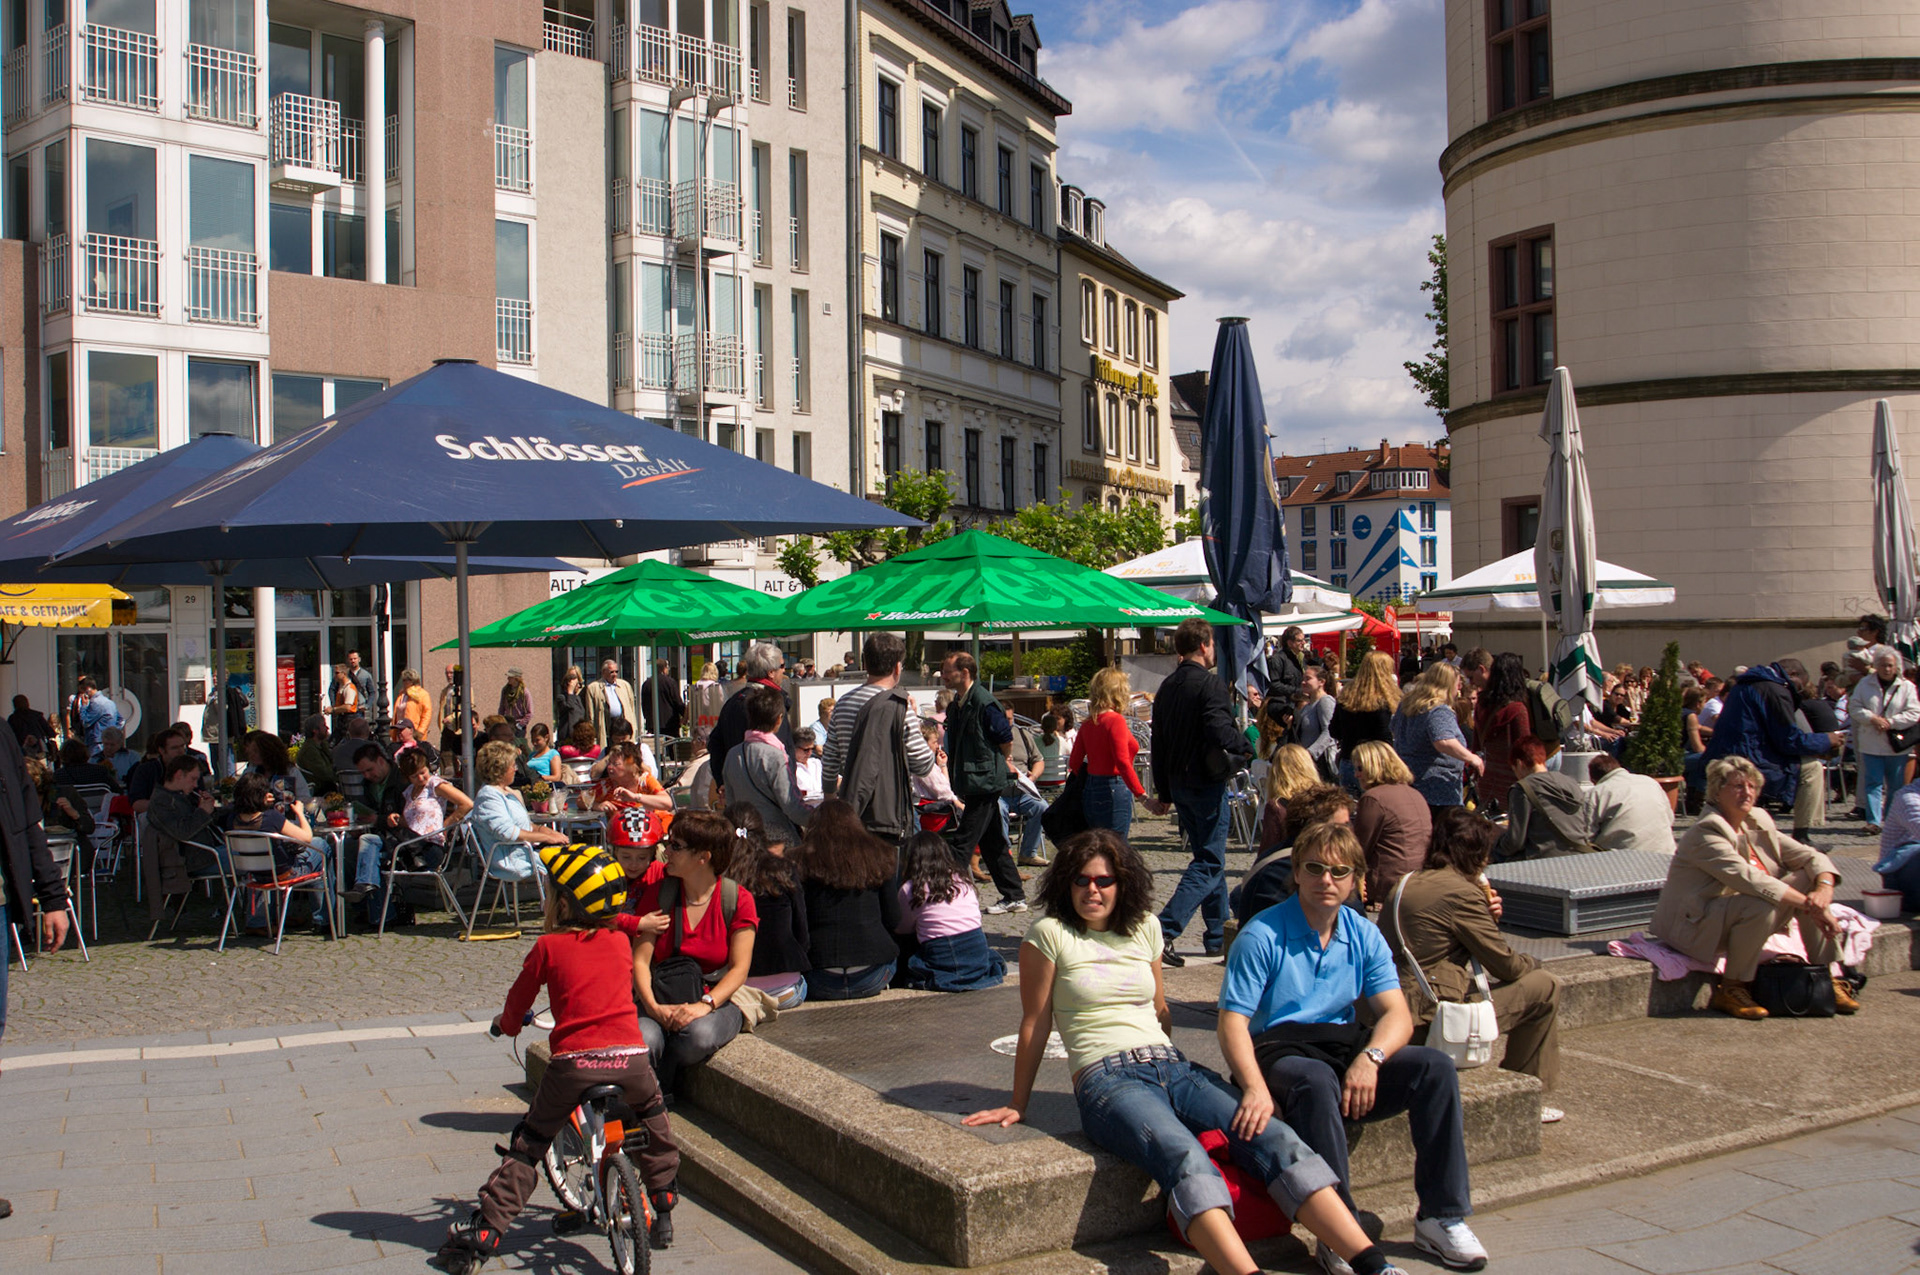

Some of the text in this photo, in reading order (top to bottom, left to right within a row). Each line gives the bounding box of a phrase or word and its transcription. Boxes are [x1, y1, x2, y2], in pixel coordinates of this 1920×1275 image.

[434, 434, 651, 463] Schlösser
[550, 579, 575, 592] ALT
[764, 580, 785, 592] ALT
[788, 580, 801, 592] &
[185, 595, 196, 604] 29
[20, 605, 29, 616] &
[880, 605, 974, 621] Heineken
[1131, 604, 1205, 617] Heineken
[575, 1056, 630, 1070] Bambi
